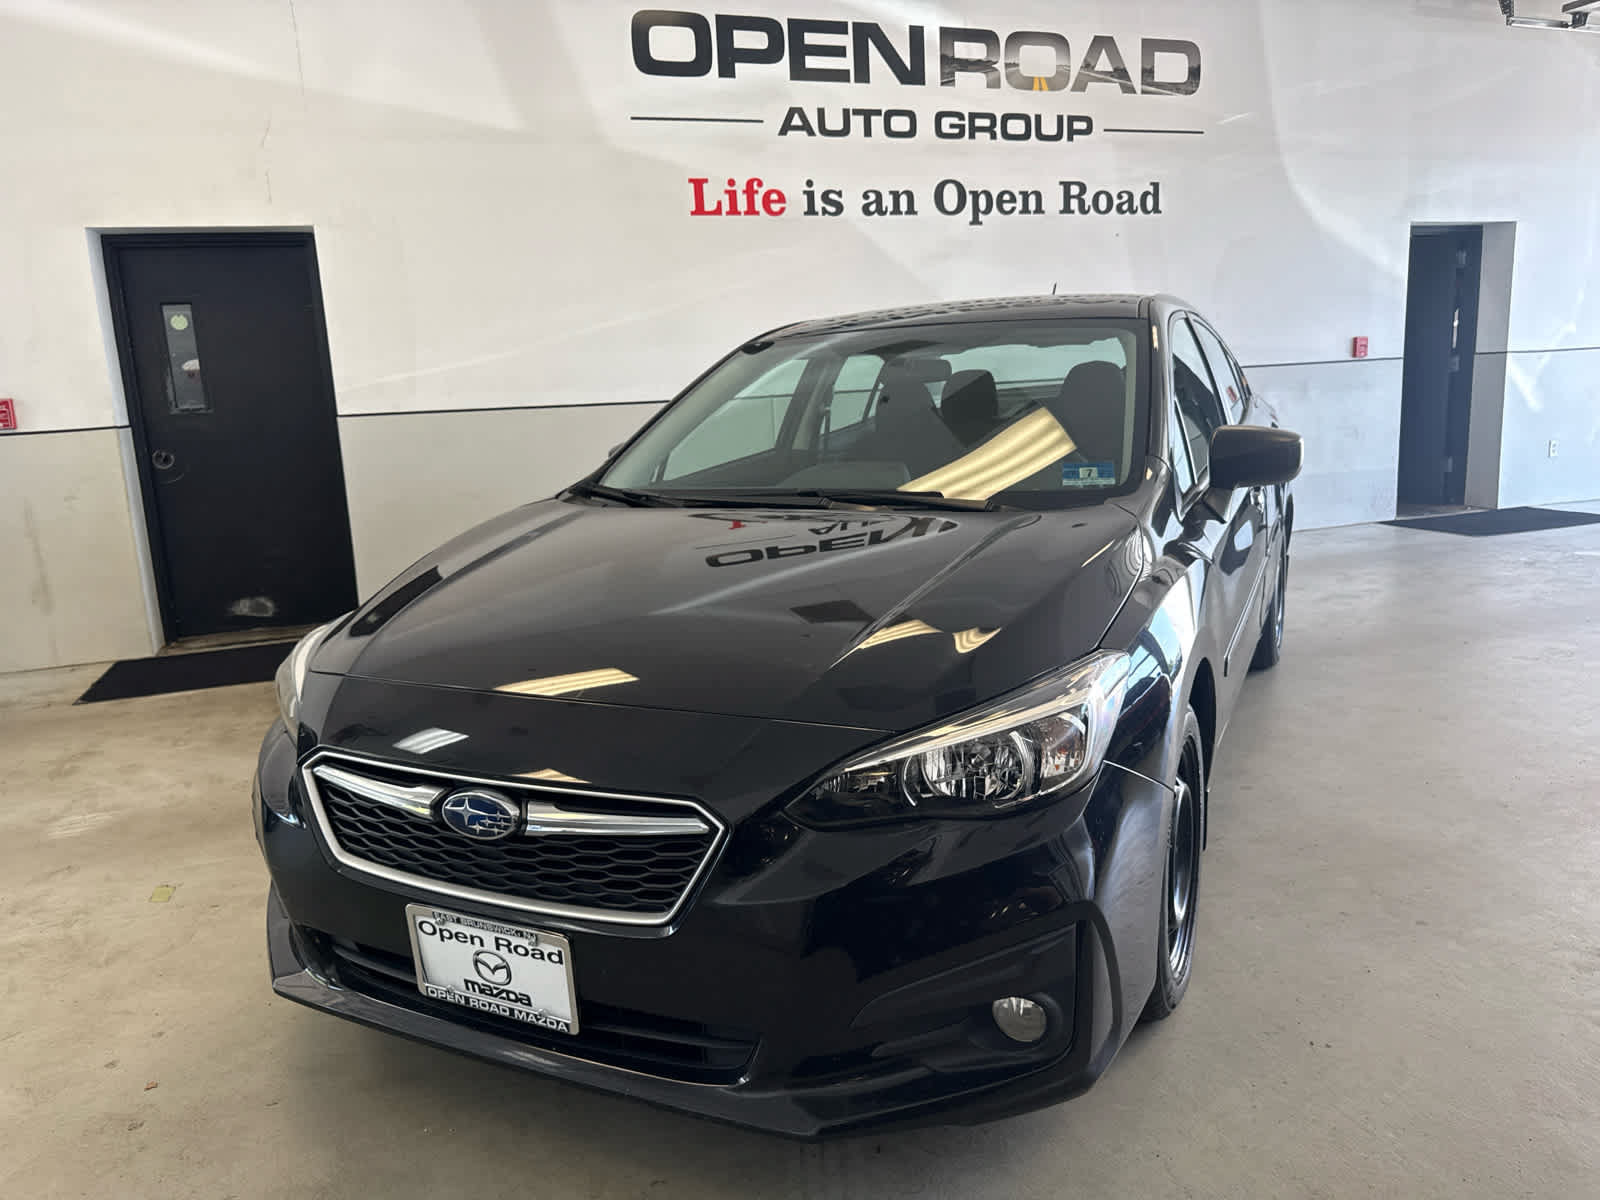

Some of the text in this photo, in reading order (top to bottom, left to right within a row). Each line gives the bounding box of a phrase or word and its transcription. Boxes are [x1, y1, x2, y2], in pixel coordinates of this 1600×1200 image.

[631, 9, 1201, 96] OPEN ROAD
[778, 106, 1094, 142] AUTO GROUP
[688, 177, 1162, 226] Life is an Open Road
[418, 920, 564, 965] Open Road
[427, 986, 569, 1032] OPEN ROAD MAZDA
